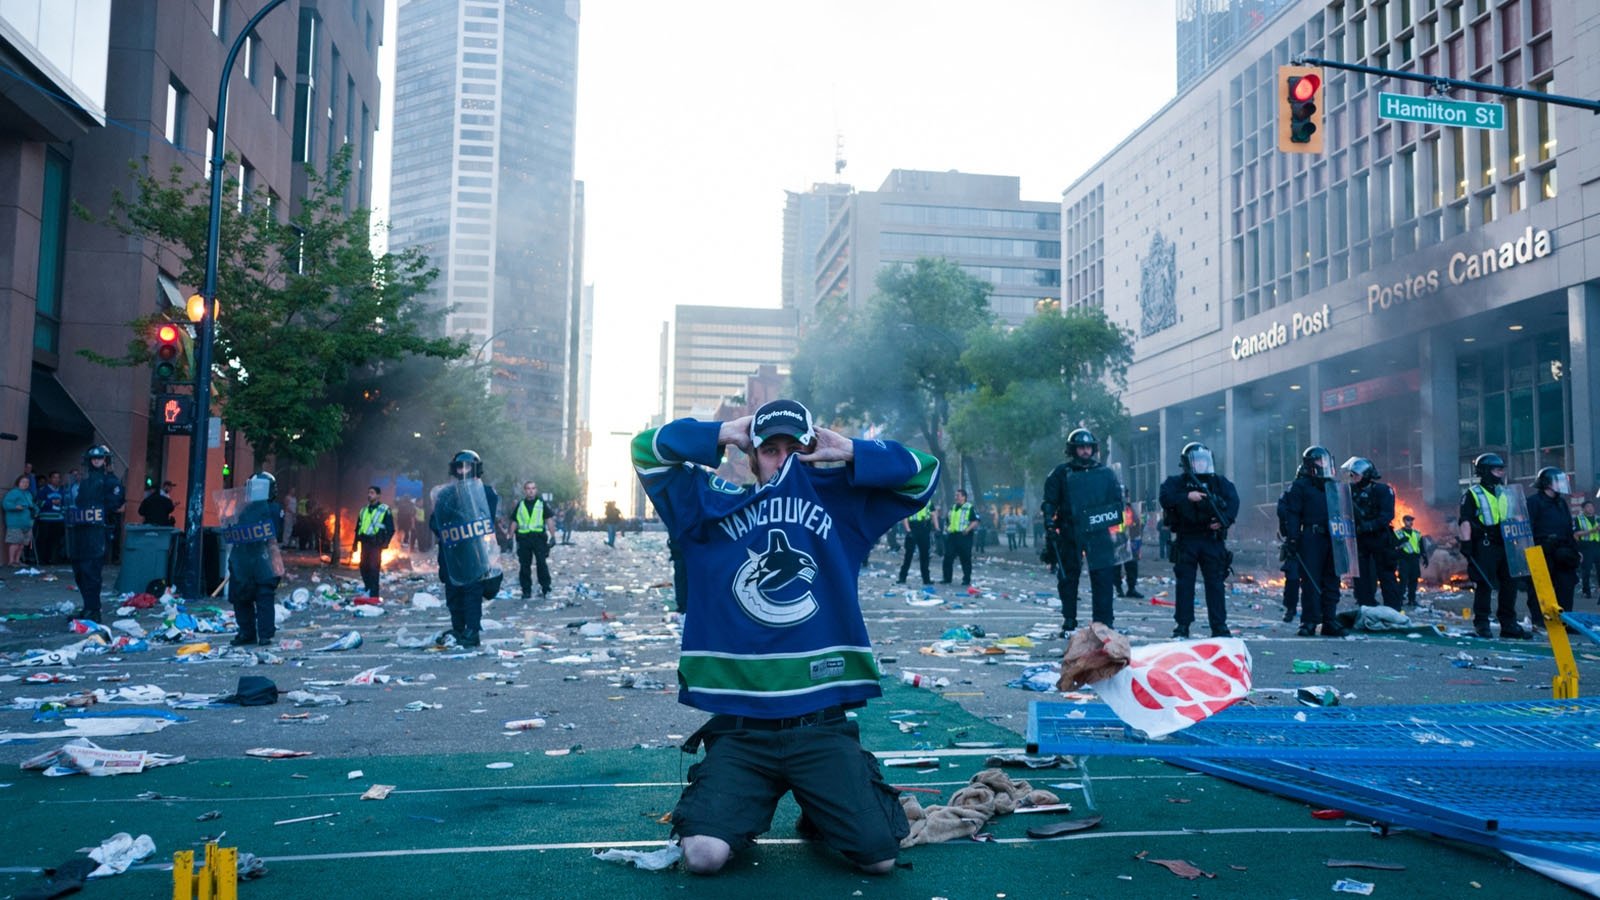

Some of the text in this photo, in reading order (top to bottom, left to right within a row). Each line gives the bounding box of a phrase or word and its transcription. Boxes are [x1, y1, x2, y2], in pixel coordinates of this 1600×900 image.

[1386, 98, 1496, 125] Hamilton St
[1367, 225, 1552, 314] Postes Canada
[1231, 303, 1330, 361] Canada Post
[757, 410, 803, 425] TaylorMade
[718, 496, 833, 541] VANCOUVER
[1088, 510, 1118, 525] POLICE
[224, 522, 273, 541] POLICE
[441, 519, 493, 543] POLICE
